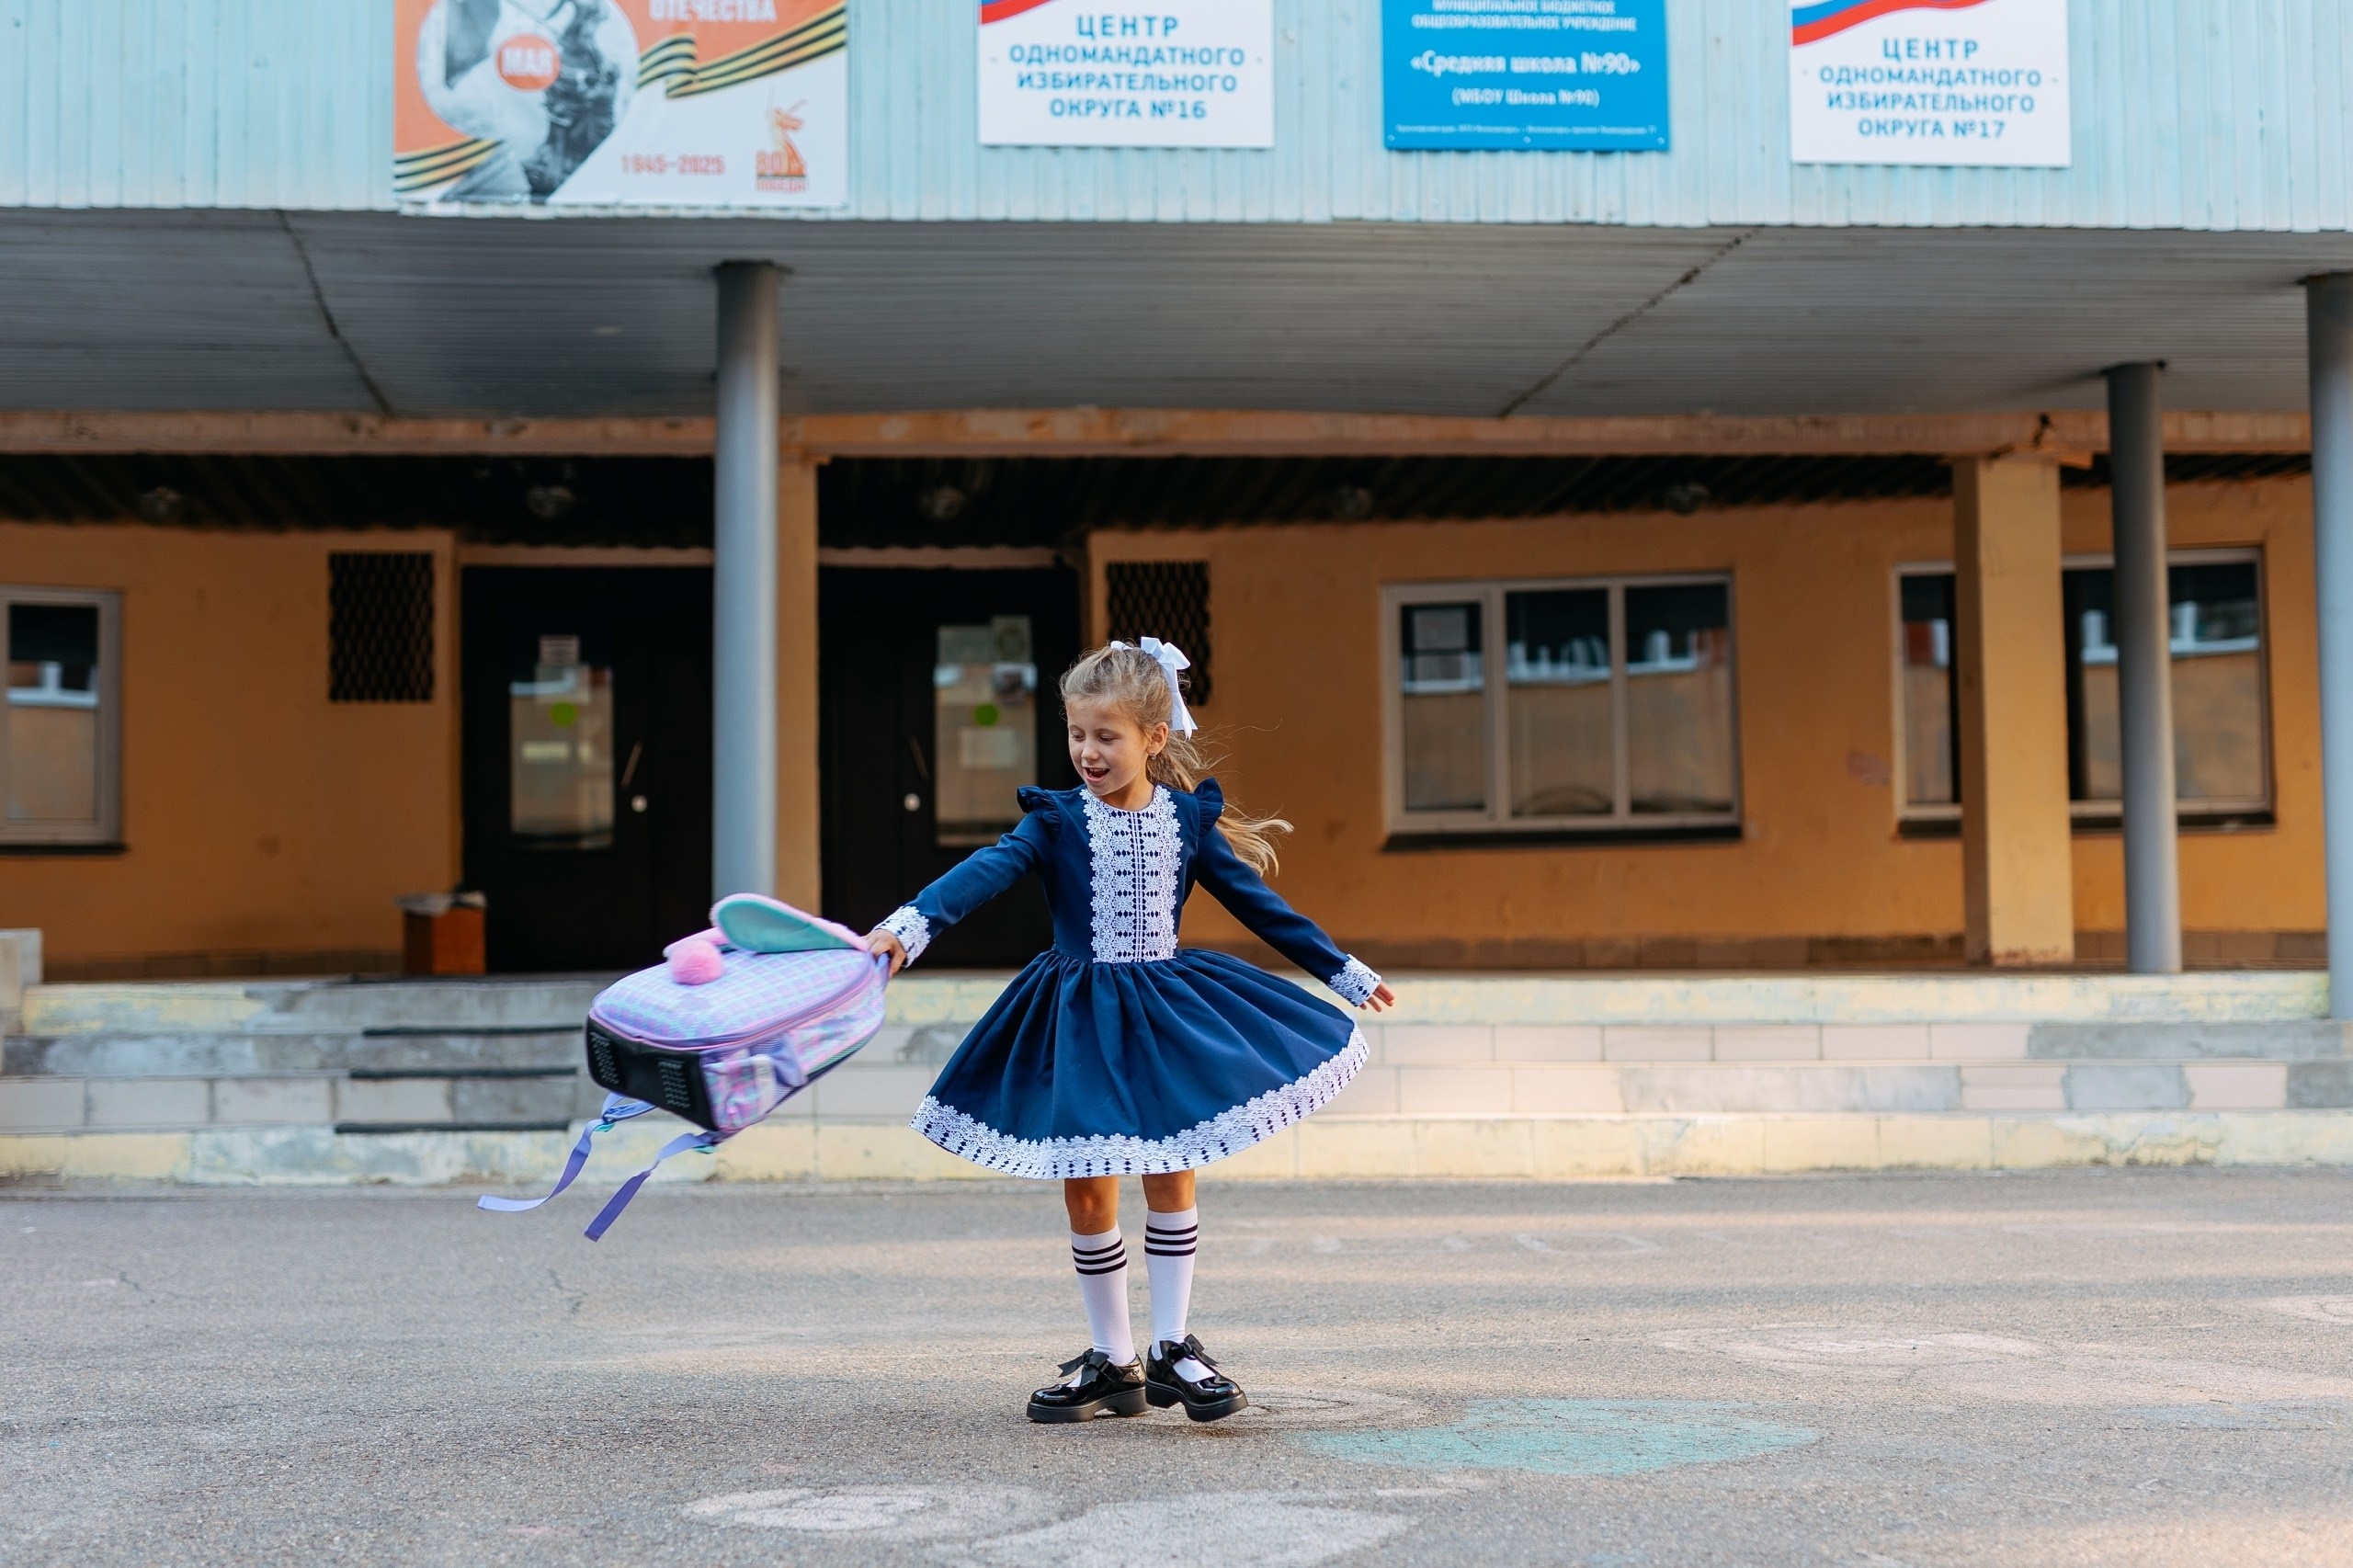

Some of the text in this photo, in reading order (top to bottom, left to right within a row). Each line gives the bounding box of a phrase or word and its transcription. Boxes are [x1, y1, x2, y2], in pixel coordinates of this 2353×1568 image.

[650, 0, 777, 22] ОТЕЧЕСТВА
[1077, 16, 1178, 40] ЦЕНТР
[1563, 17, 1638, 32] УЧРЕЖДЕНИЕ
[1009, 44, 1245, 67] ОДНОМАНДАТНОГО
[1883, 39, 1979, 62] ЦЕНТР
[501, 48, 552, 76] МАЯ
[1410, 51, 1642, 77] «Средняя школа №90»
[1017, 72, 1237, 93] ИЗБИРАТЕЛЬНОГО
[1820, 66, 2042, 87] ОДНОМАНДАТНОГО
[1451, 87, 1504, 107] (МБОУ
[1506, 89, 1556, 106] Школа
[1827, 92, 2035, 113] ИЗБИРАТЕЛЬНОГО
[1050, 99, 1207, 119] ОКРУГА №16
[1859, 119, 2006, 139] ОКРУГА №17
